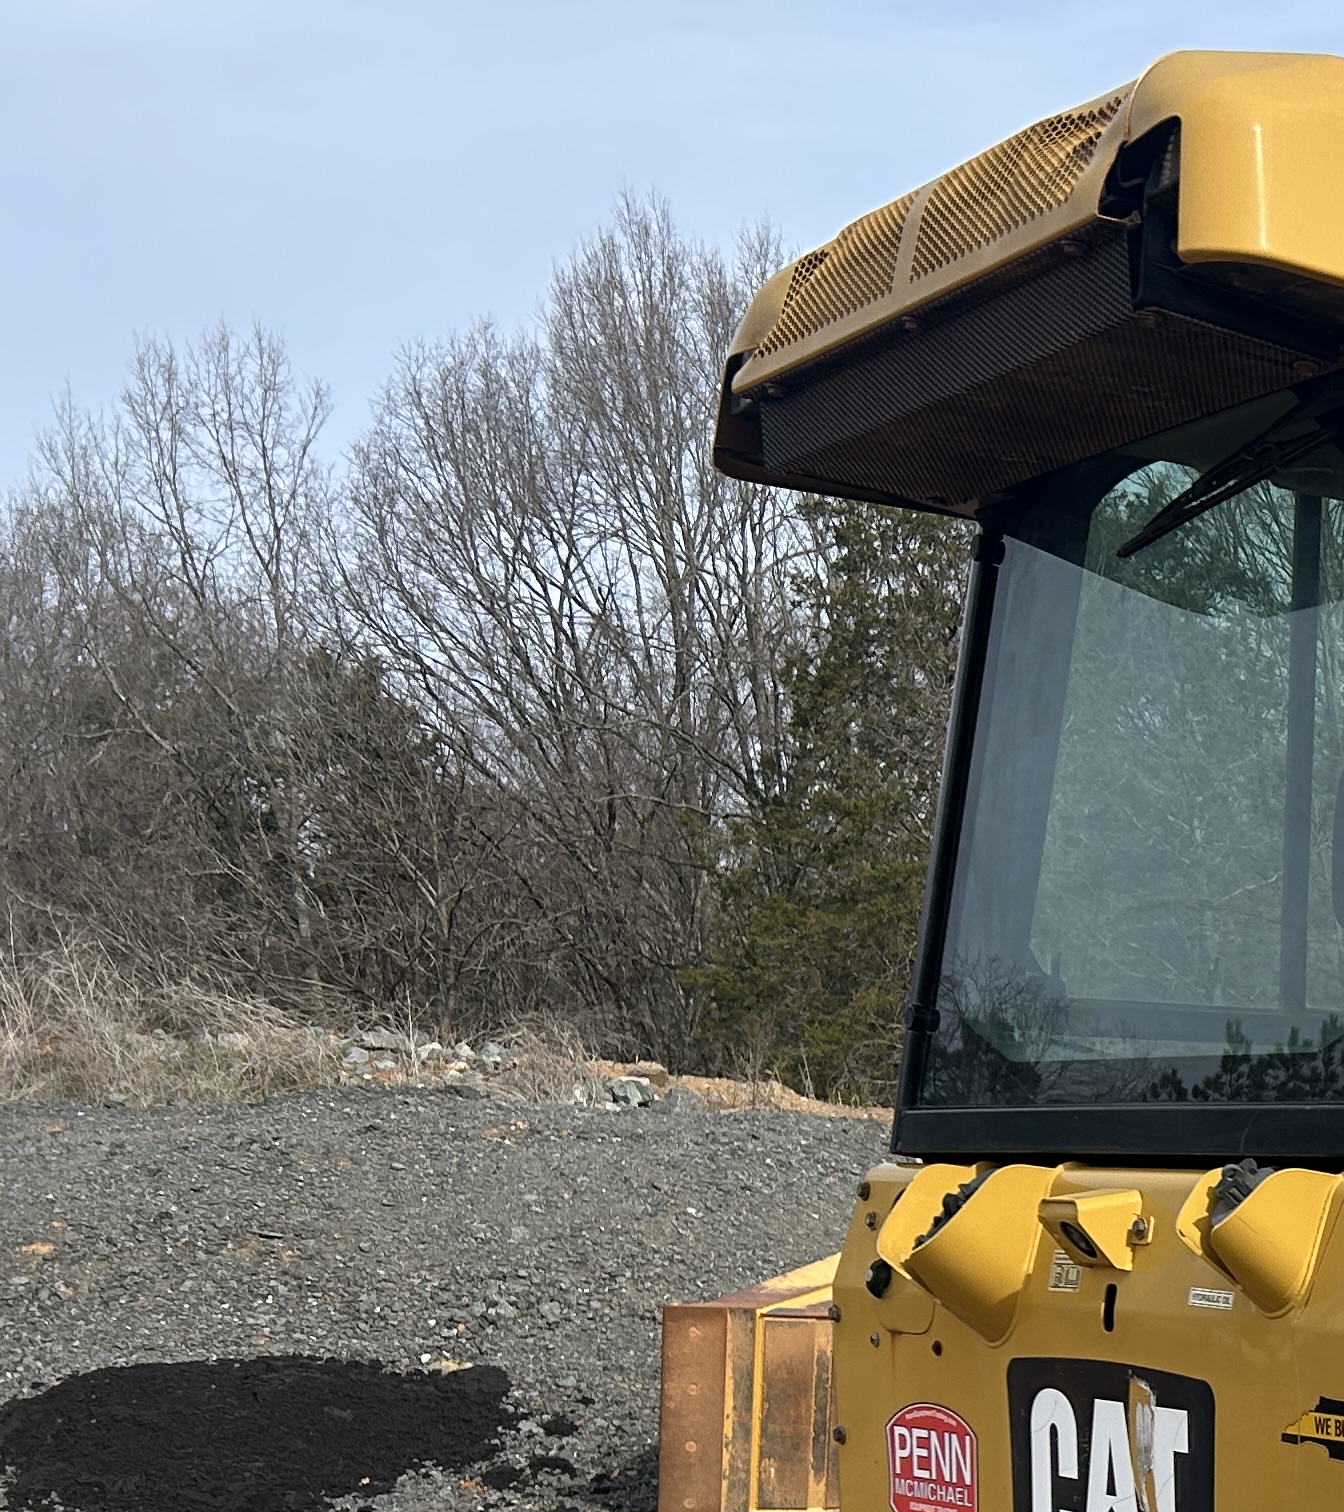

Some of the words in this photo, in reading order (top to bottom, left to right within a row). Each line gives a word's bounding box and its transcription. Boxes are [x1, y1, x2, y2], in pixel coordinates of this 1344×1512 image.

[1313, 1416, 1332, 1436] WE
[892, 1425, 972, 1486] PENN
[894, 1477, 973, 1507] MCMICHAEL
